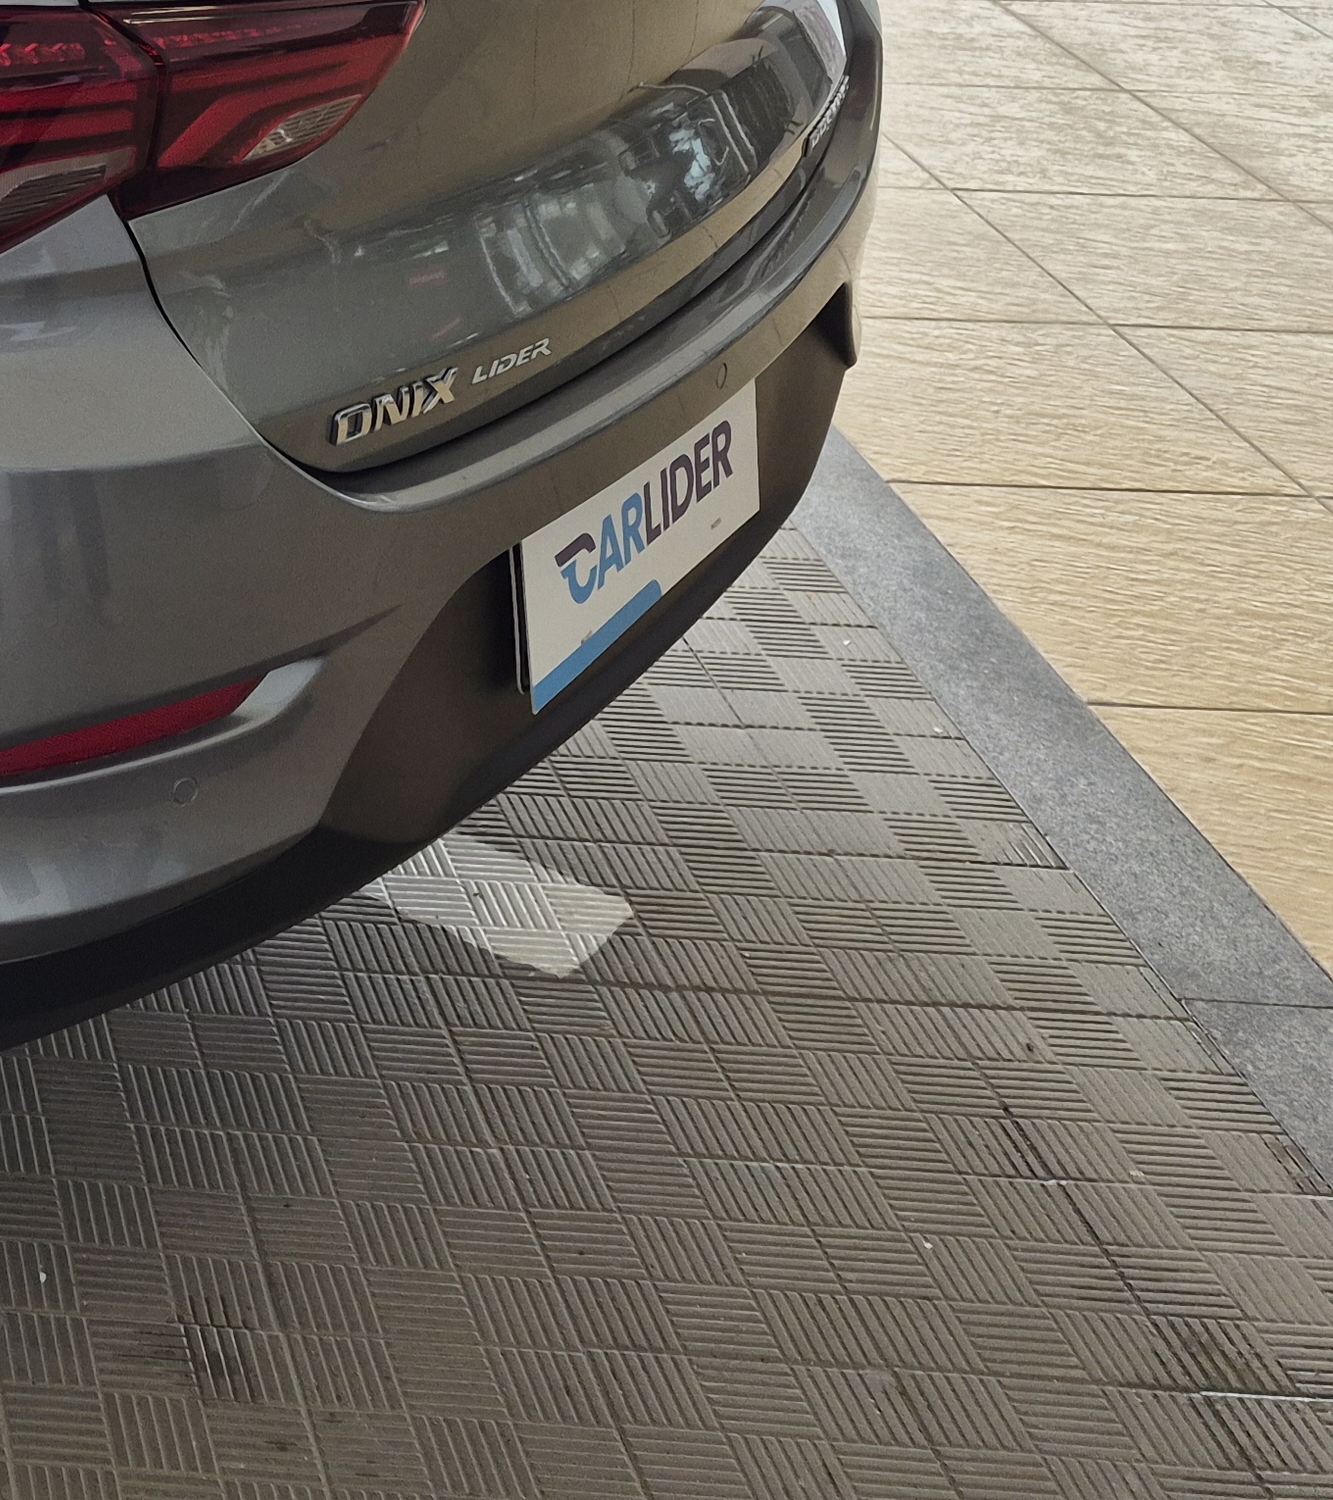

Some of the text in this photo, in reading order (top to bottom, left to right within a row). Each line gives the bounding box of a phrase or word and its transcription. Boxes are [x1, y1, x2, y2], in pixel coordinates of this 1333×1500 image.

[330, 337, 553, 446] ONIX LIDER
[554, 419, 734, 605] CARLIDER
